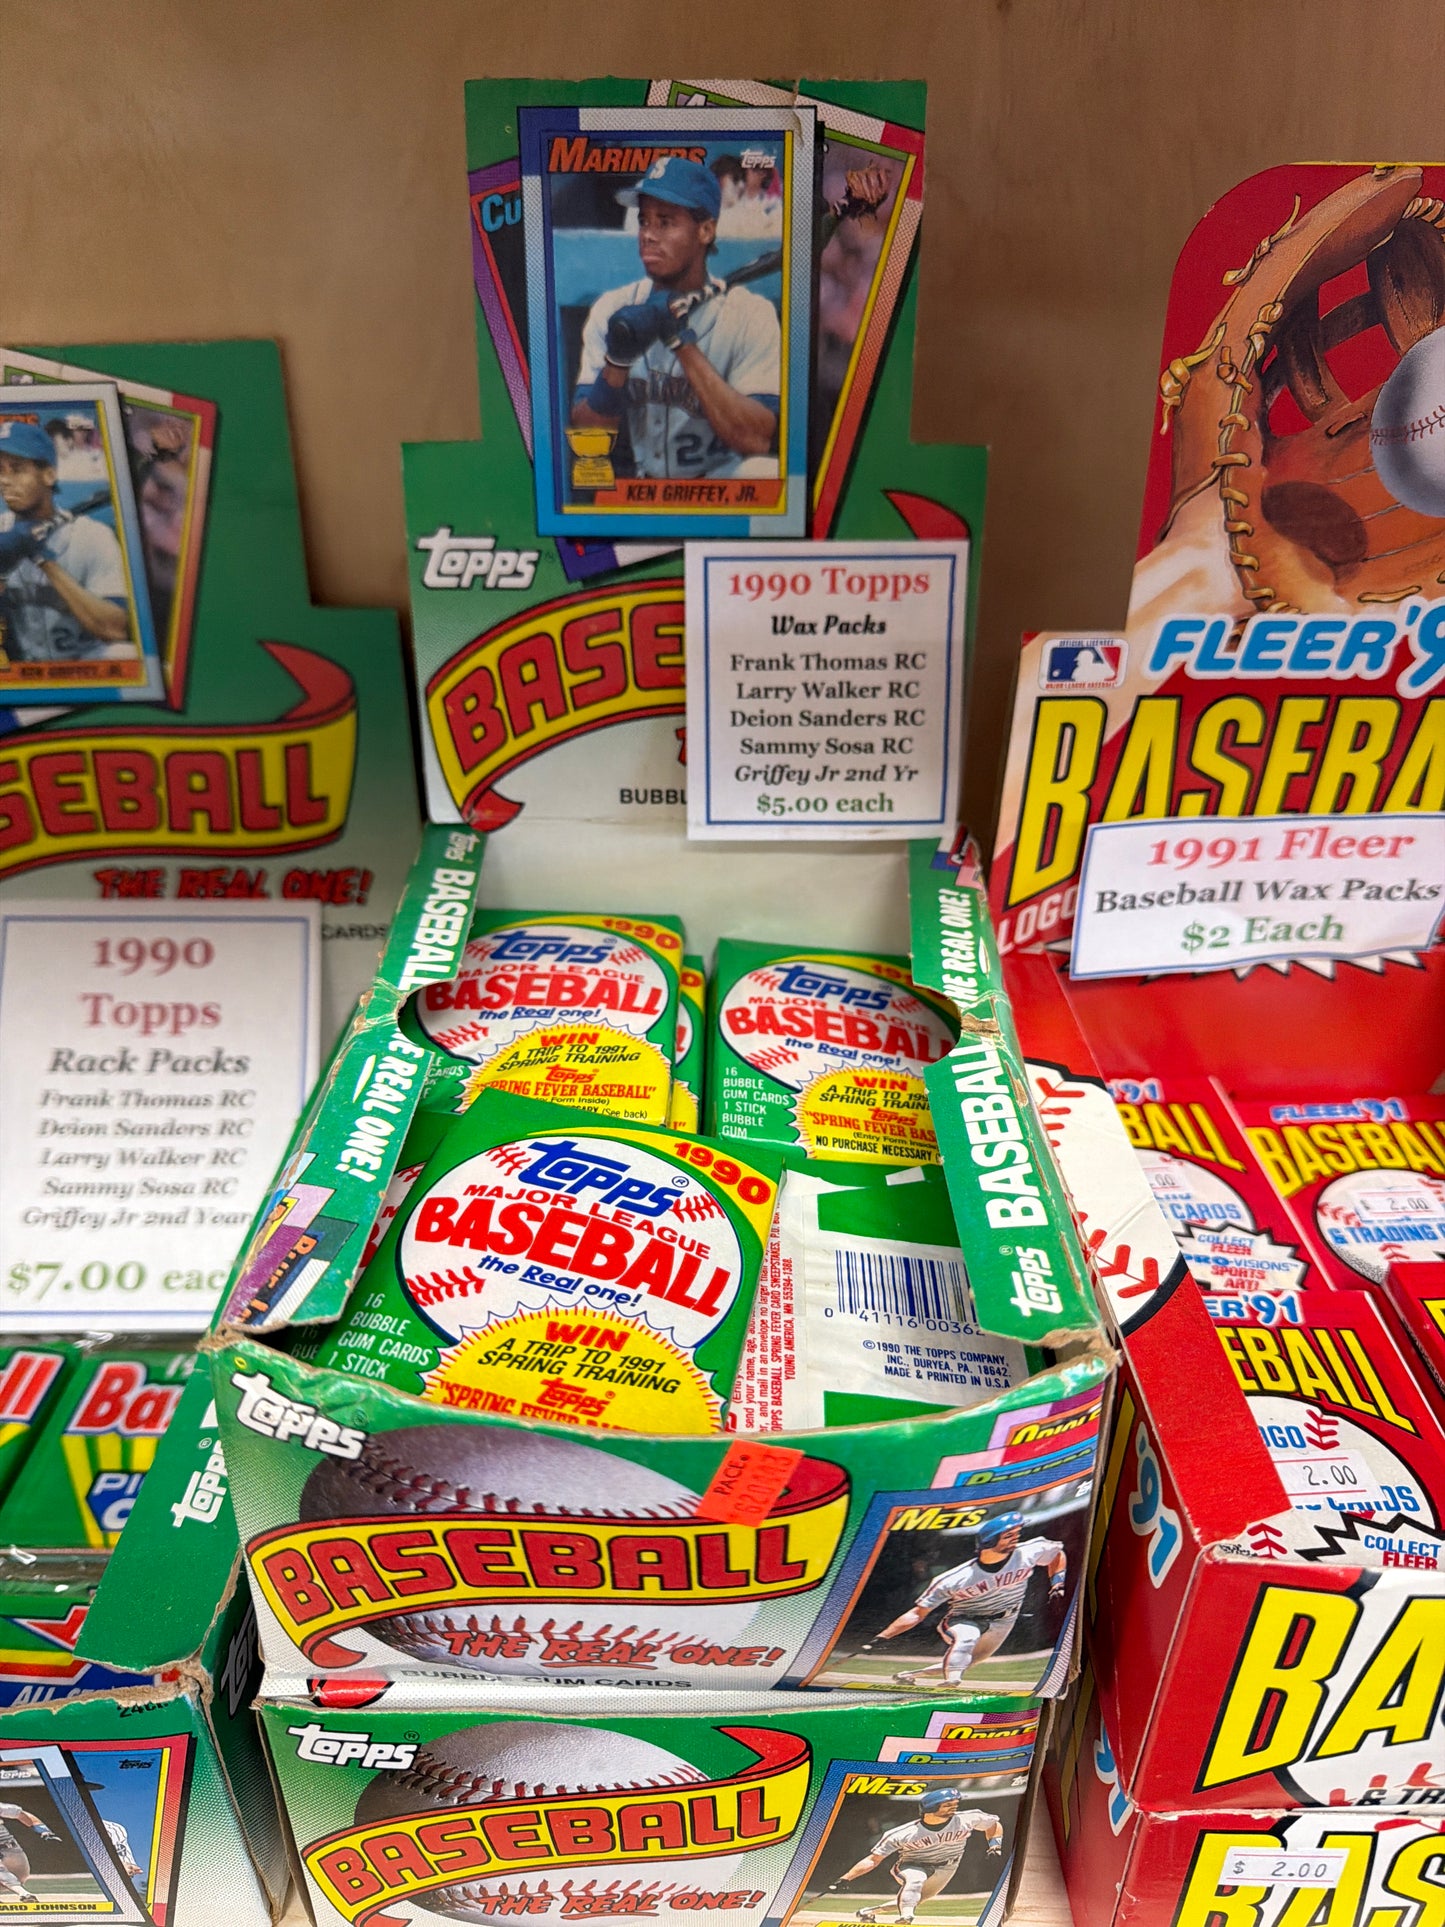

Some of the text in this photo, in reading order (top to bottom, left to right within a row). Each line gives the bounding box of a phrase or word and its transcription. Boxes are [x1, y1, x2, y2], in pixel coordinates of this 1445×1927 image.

[626, 484, 657, 502] KEN
[728, 566, 931, 602] 1990 Topps
[771, 614, 887, 636] Wax Packs
[730, 652, 928, 672] Frank Thomas RC
[736, 681, 921, 704] Larry Walker RC
[730, 709, 927, 728] Deion Sanders RC
[739, 737, 914, 759] Sammy Sosa RC
[734, 764, 919, 787] Griffey Jr 2nd Yr
[757, 792, 895, 817] $5.00 each
[1146, 826, 1416, 871] 1991 Fleer
[93, 869, 167, 900] THE
[176, 868, 272, 900] REAL
[1094, 877, 1443, 914] Baseball Wax Packs
[398, 867, 477, 991] BASEBALL
[601, 918, 682, 952] 1990
[1181, 914, 1344, 953] $2 Each
[93, 935, 216, 977] 1990
[546, 963, 646, 984] LEAGUE
[424, 973, 670, 1016] BASEBALL
[748, 996, 828, 1010] MAJOR
[80, 992, 223, 1037] Topps
[478, 1006, 601, 1021] the Real one!
[540, 1032, 600, 1047] WIN
[784, 1036, 858, 1060] the Real
[47, 1046, 251, 1075] Rack Packs
[496, 1052, 641, 1072] SPRING TRAINING
[526, 1044, 589, 1059] TRIP TO
[724, 1066, 739, 1078] 16
[852, 1075, 909, 1092] WIN
[530, 1082, 580, 1097] FEVER
[723, 1078, 765, 1091] BUBBLE
[844, 1085, 901, 1100] TRIP TO
[40, 1088, 256, 1108] Frank Thomas RC
[723, 1089, 790, 1107] GUM CARDS
[734, 1101, 768, 1116] STICK
[818, 1092, 877, 1107] SPRING
[37, 1118, 252, 1138] Deion Sanders RC
[722, 1112, 765, 1127] BUBBLE
[863, 1119, 909, 1139] FEVER
[721, 1125, 748, 1139] GUM
[40, 1148, 248, 1170] Larry Walker RC
[336, 1118, 396, 1183] ONE!
[815, 1135, 935, 1162] NO PURCHASE NECESSARY
[673, 1141, 772, 1206] 1990
[43, 1177, 238, 1200] Sammy Sosa RC
[22, 1206, 139, 1230] Griffey Jr
[462, 1183, 712, 1261] MAJOR LEAGUE
[1171, 1202, 1242, 1221] CARDS
[1198, 1232, 1255, 1247] COLLECT
[1348, 1223, 1436, 1244] TRADING
[413, 1196, 732, 1319] BASEBALL
[8, 1260, 147, 1302] $7.00
[476, 1253, 643, 1308] the Real one!
[363, 1292, 386, 1309] 16
[349, 1310, 411, 1338] BUBBLE
[824, 1307, 918, 1329] 0 41116
[545, 1320, 631, 1352] WIN
[757, 1319, 769, 1353] envelope
[337, 1330, 375, 1352] GUM
[378, 1337, 434, 1367] CARDS
[526, 1340, 667, 1375] TRIP TO 1991
[770, 1310, 783, 1407] BASEBALL SPRING FEVER
[904, 1344, 1010, 1367] THE TOPPS COMPANY,
[341, 1352, 391, 1381] STICK
[477, 1350, 682, 1395] SPRING TRAINING
[783, 1353, 796, 1381] YOUNG
[884, 1365, 982, 1387] MADE & PRINTED IN
[913, 1357, 1012, 1378] DURYEA, PA. 18642.
[1302, 1464, 1358, 1486] 2.00
[1363, 1534, 1442, 1559] COLLECT
[262, 1522, 808, 1624] BASEBALL
[442, 1630, 786, 1671] THE REAL ONE!
[594, 1676, 693, 1689] CARDS
[320, 1787, 783, 1906] BASEBALL
[1271, 1861, 1329, 1878] 2.00
[32, 1902, 98, 1911] JOHNSON
[480, 1890, 767, 1919] THE REAL ONE!
